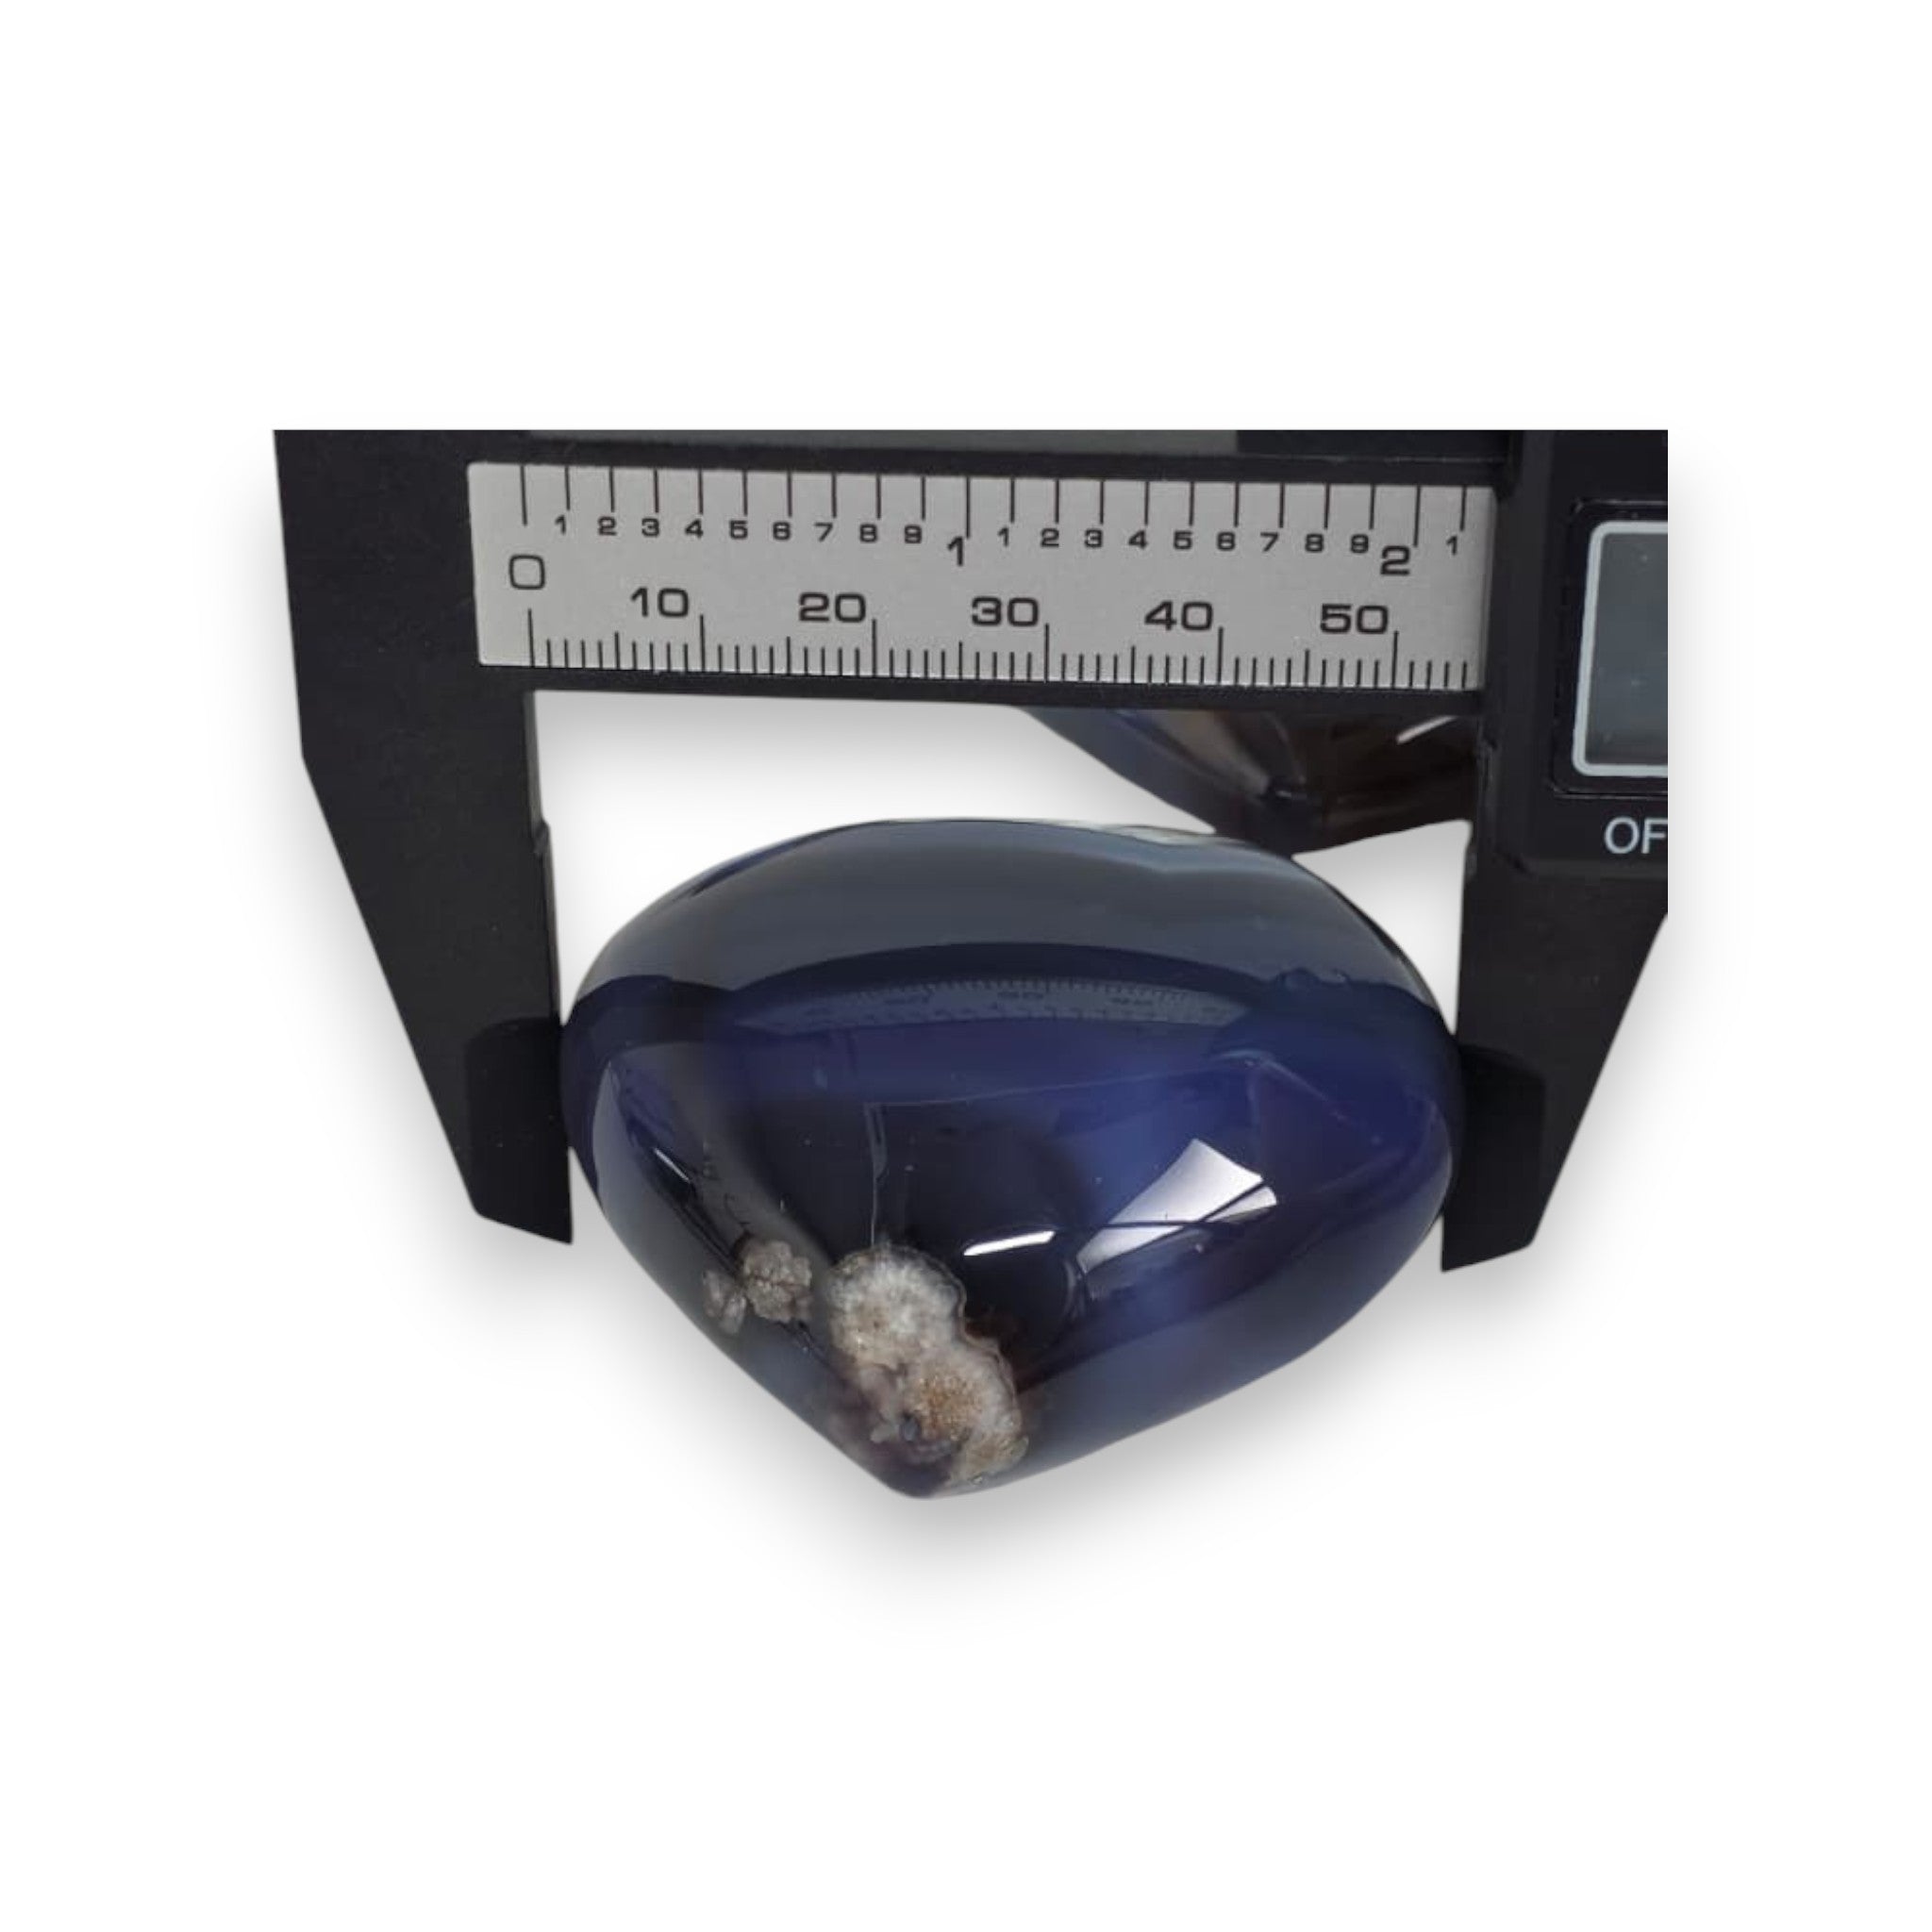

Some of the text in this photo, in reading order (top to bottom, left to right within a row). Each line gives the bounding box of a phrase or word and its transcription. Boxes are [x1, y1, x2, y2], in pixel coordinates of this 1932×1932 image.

[554, 513, 1458, 577] 1 2 3 4 5 6 7 8 9 1 1 2 3 4 5 6 7 8 9 2 1
[508, 553, 1390, 635] 0 10 20 30 40 50
[1604, 816, 1668, 855] OF
